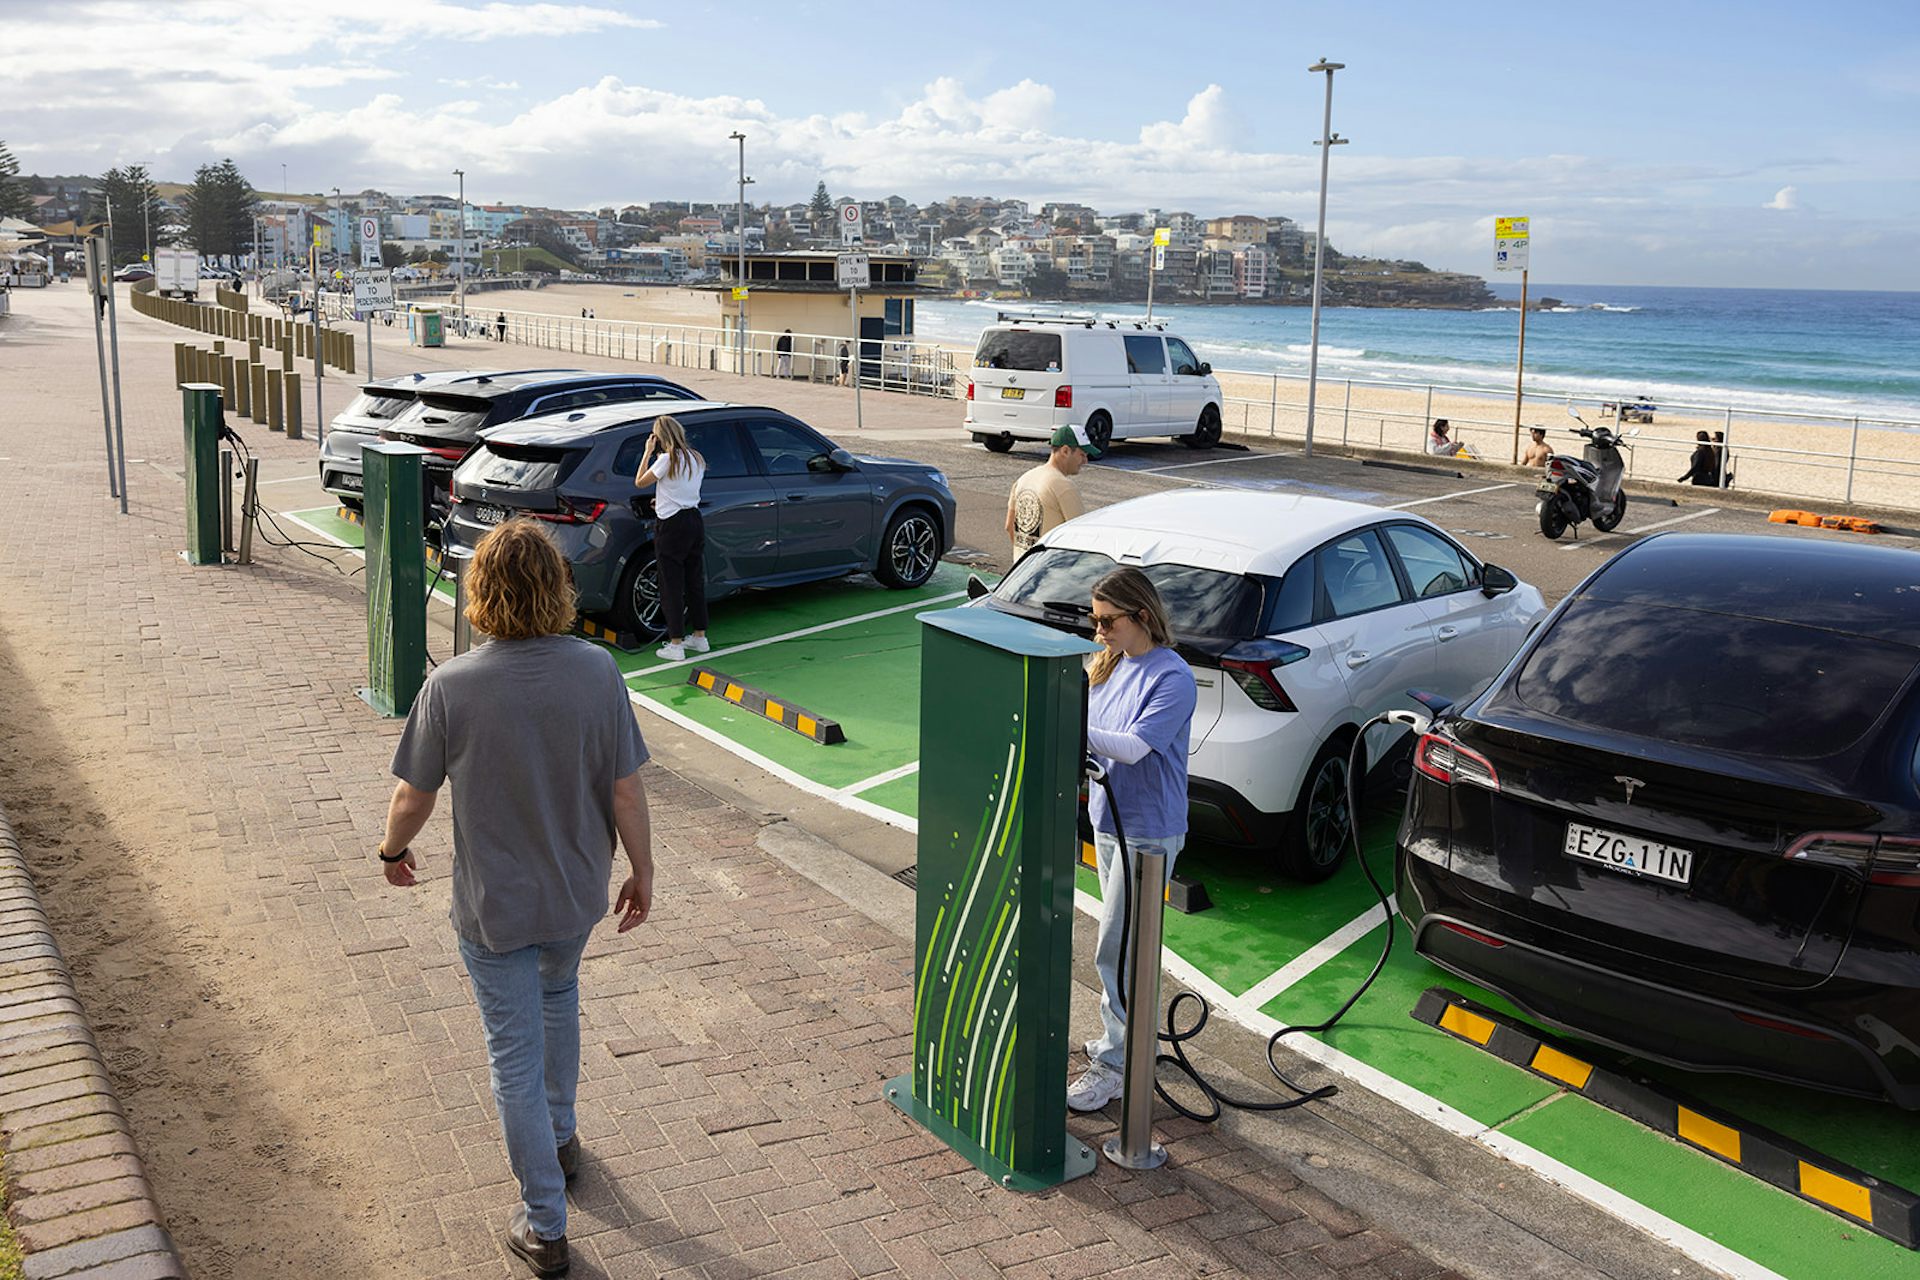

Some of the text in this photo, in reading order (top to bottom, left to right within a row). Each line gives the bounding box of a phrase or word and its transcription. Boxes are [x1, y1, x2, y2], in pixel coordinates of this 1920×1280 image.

[1499, 240, 1528, 249] P 4P
[850, 267, 858, 275] TO
[355, 275, 388, 285] GIVE WAY
[367, 286, 378, 295] TO
